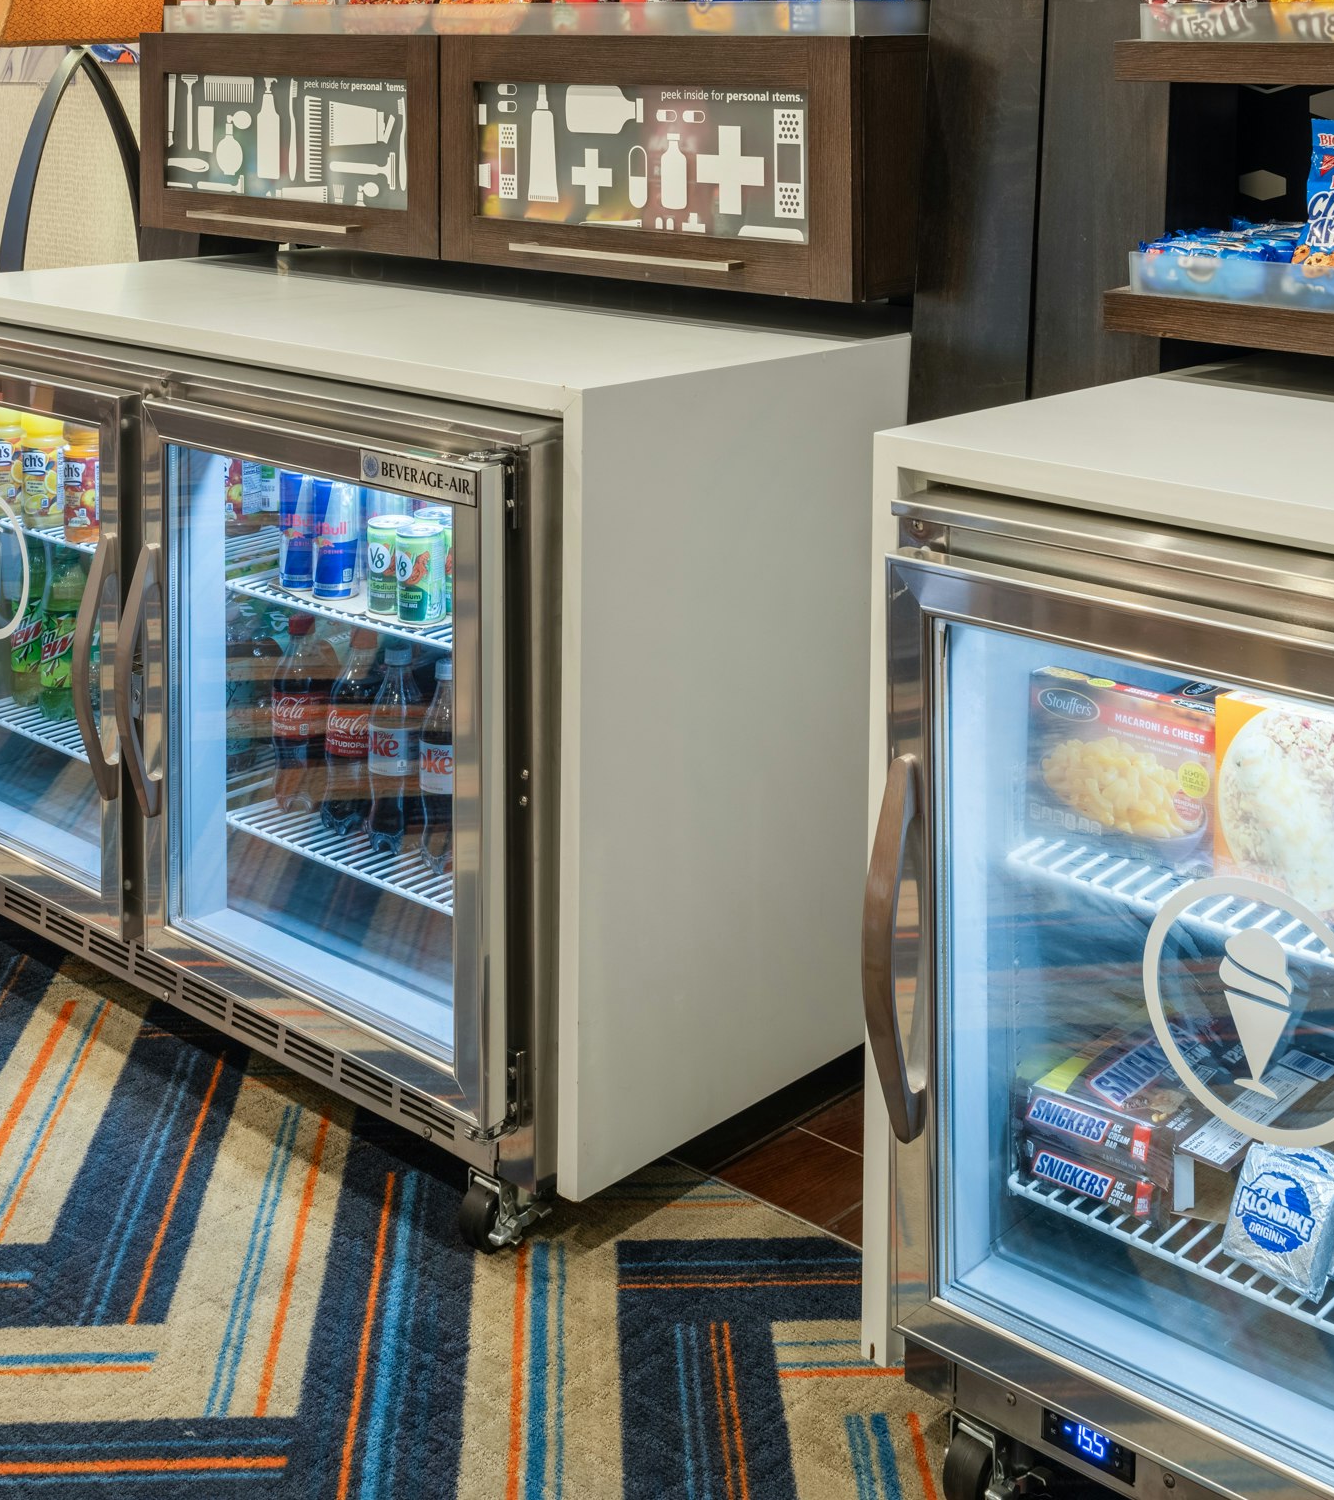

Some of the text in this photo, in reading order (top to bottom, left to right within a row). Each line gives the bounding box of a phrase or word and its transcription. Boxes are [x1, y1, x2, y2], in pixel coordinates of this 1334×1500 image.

[304, 80, 319, 89] peek
[339, 80, 350, 90] for
[350, 82, 382, 93] personal
[384, 82, 408, 93] tems.
[661, 89, 682, 101] peek
[683, 89, 709, 100] inside
[710, 89, 725, 100] for
[726, 91, 769, 104] personal
[380, 462, 471, 496] BEVERAGE-AIR
[369, 547, 385, 569] V8
[1046, 692, 1092, 717] Stouffer's
[379, 731, 394, 740] Diet
[1114, 713, 1161, 732] MACARONI
[1163, 725, 1169, 735] &
[1172, 727, 1206, 744] CHEESE
[433, 749, 449, 757] Diet
[1031, 1098, 1107, 1142] SNICKERS
[1112, 1123, 1123, 1134] ICE
[1104, 1139, 1118, 1150] BAR
[1108, 1131, 1131, 1147] CREAM
[1184, 1131, 1206, 1149] Nutrition
[1228, 1141, 1242, 1151] 170
[1035, 1153, 1110, 1198] SNICKERS
[1114, 1181, 1127, 1191] ICE
[1107, 1196, 1121, 1207] BAR
[1110, 1188, 1134, 1204] CREAM
[1235, 1186, 1316, 1242] KLONDIKE
